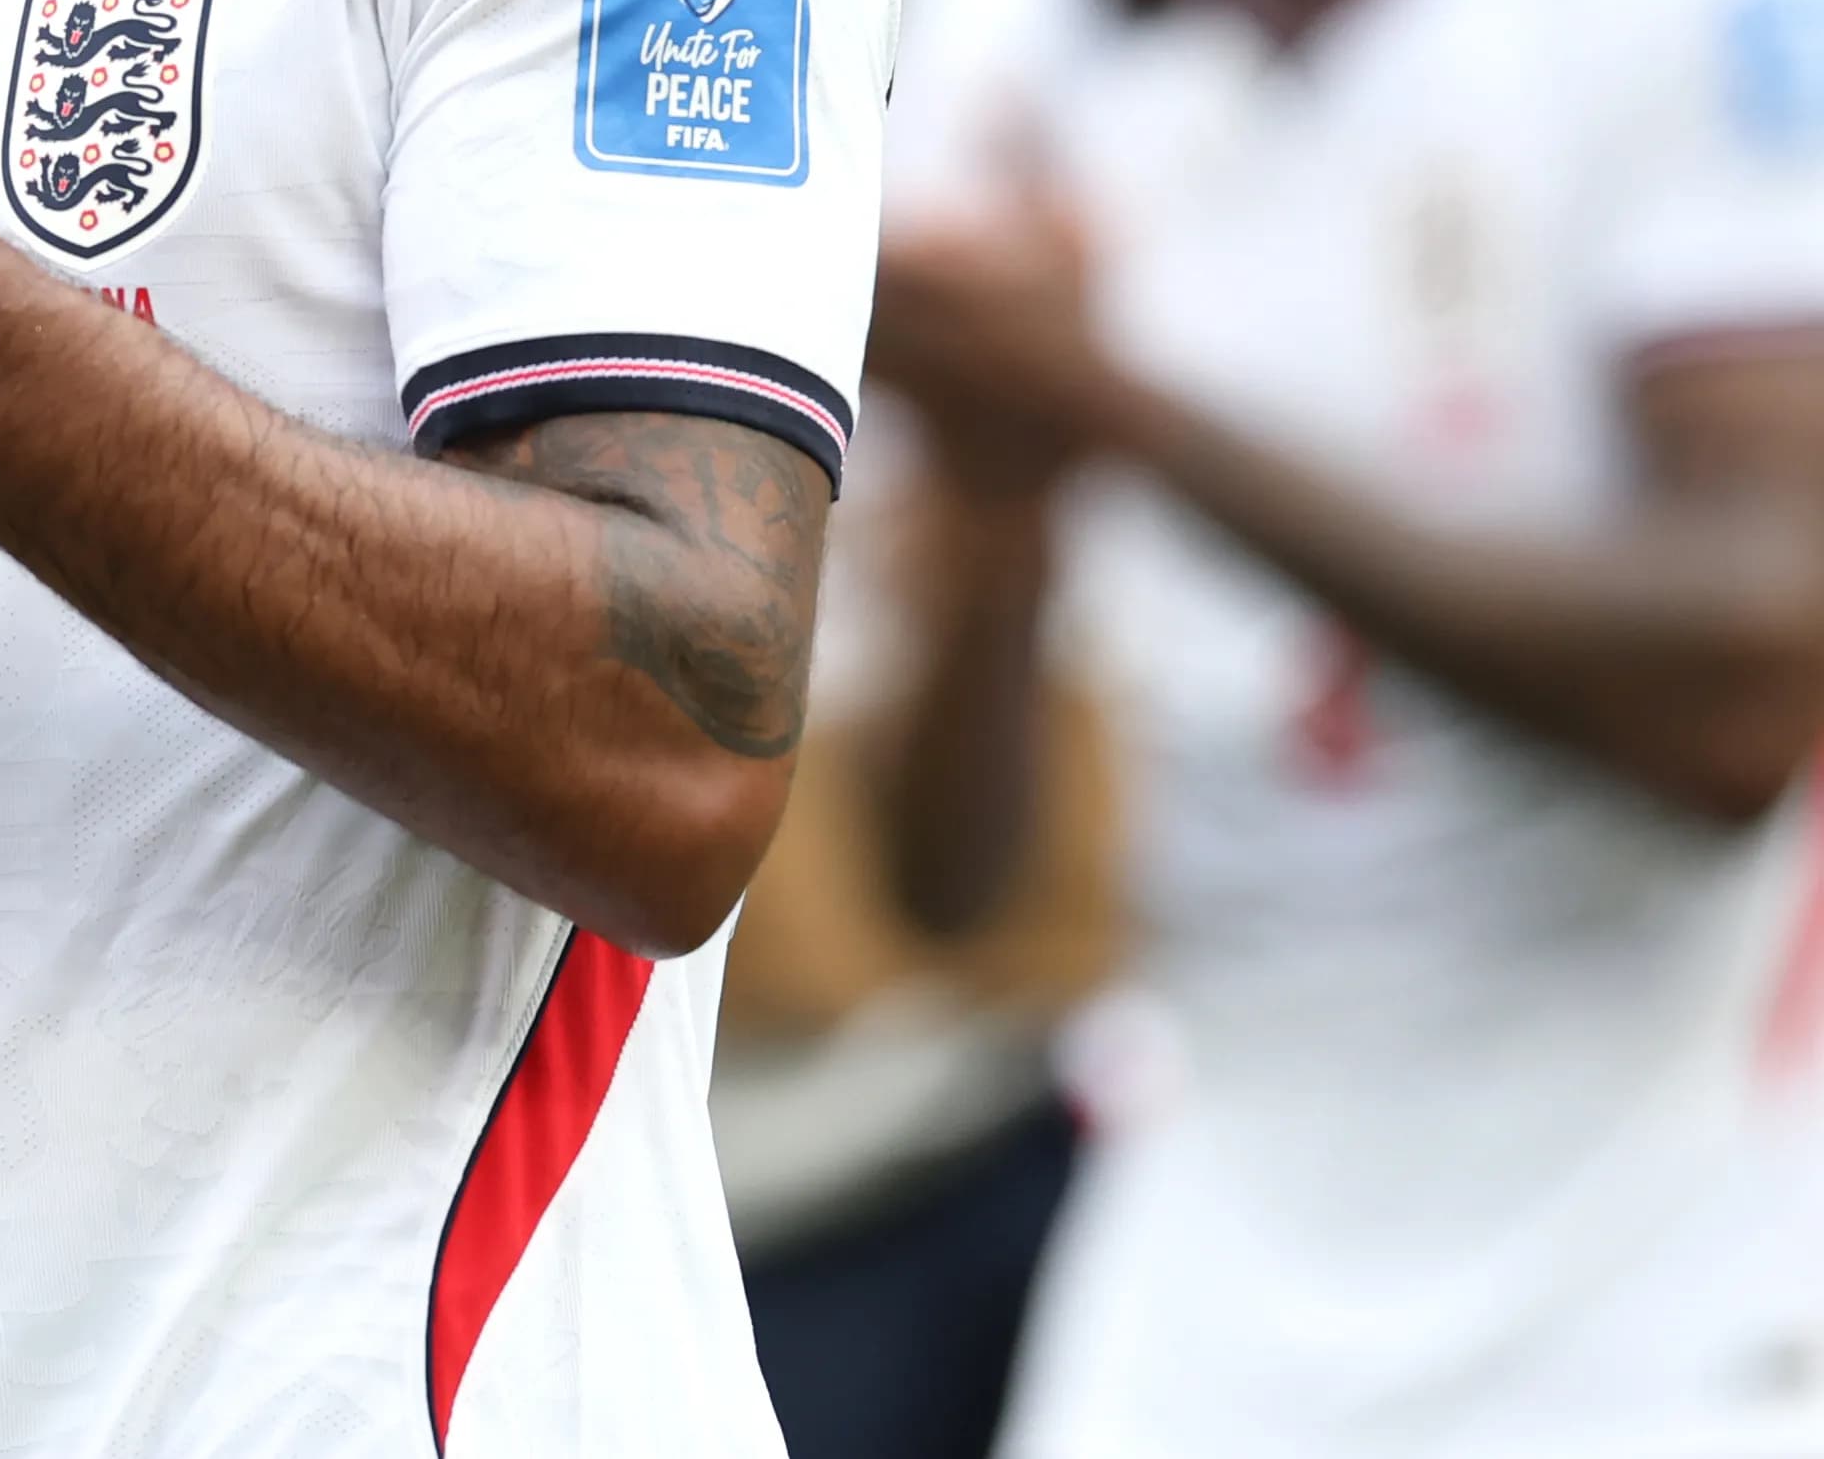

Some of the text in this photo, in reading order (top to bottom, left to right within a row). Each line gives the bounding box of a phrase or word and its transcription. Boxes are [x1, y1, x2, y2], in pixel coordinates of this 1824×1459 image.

[640, 21, 762, 74] Unite For
[645, 72, 753, 124] PEACE
